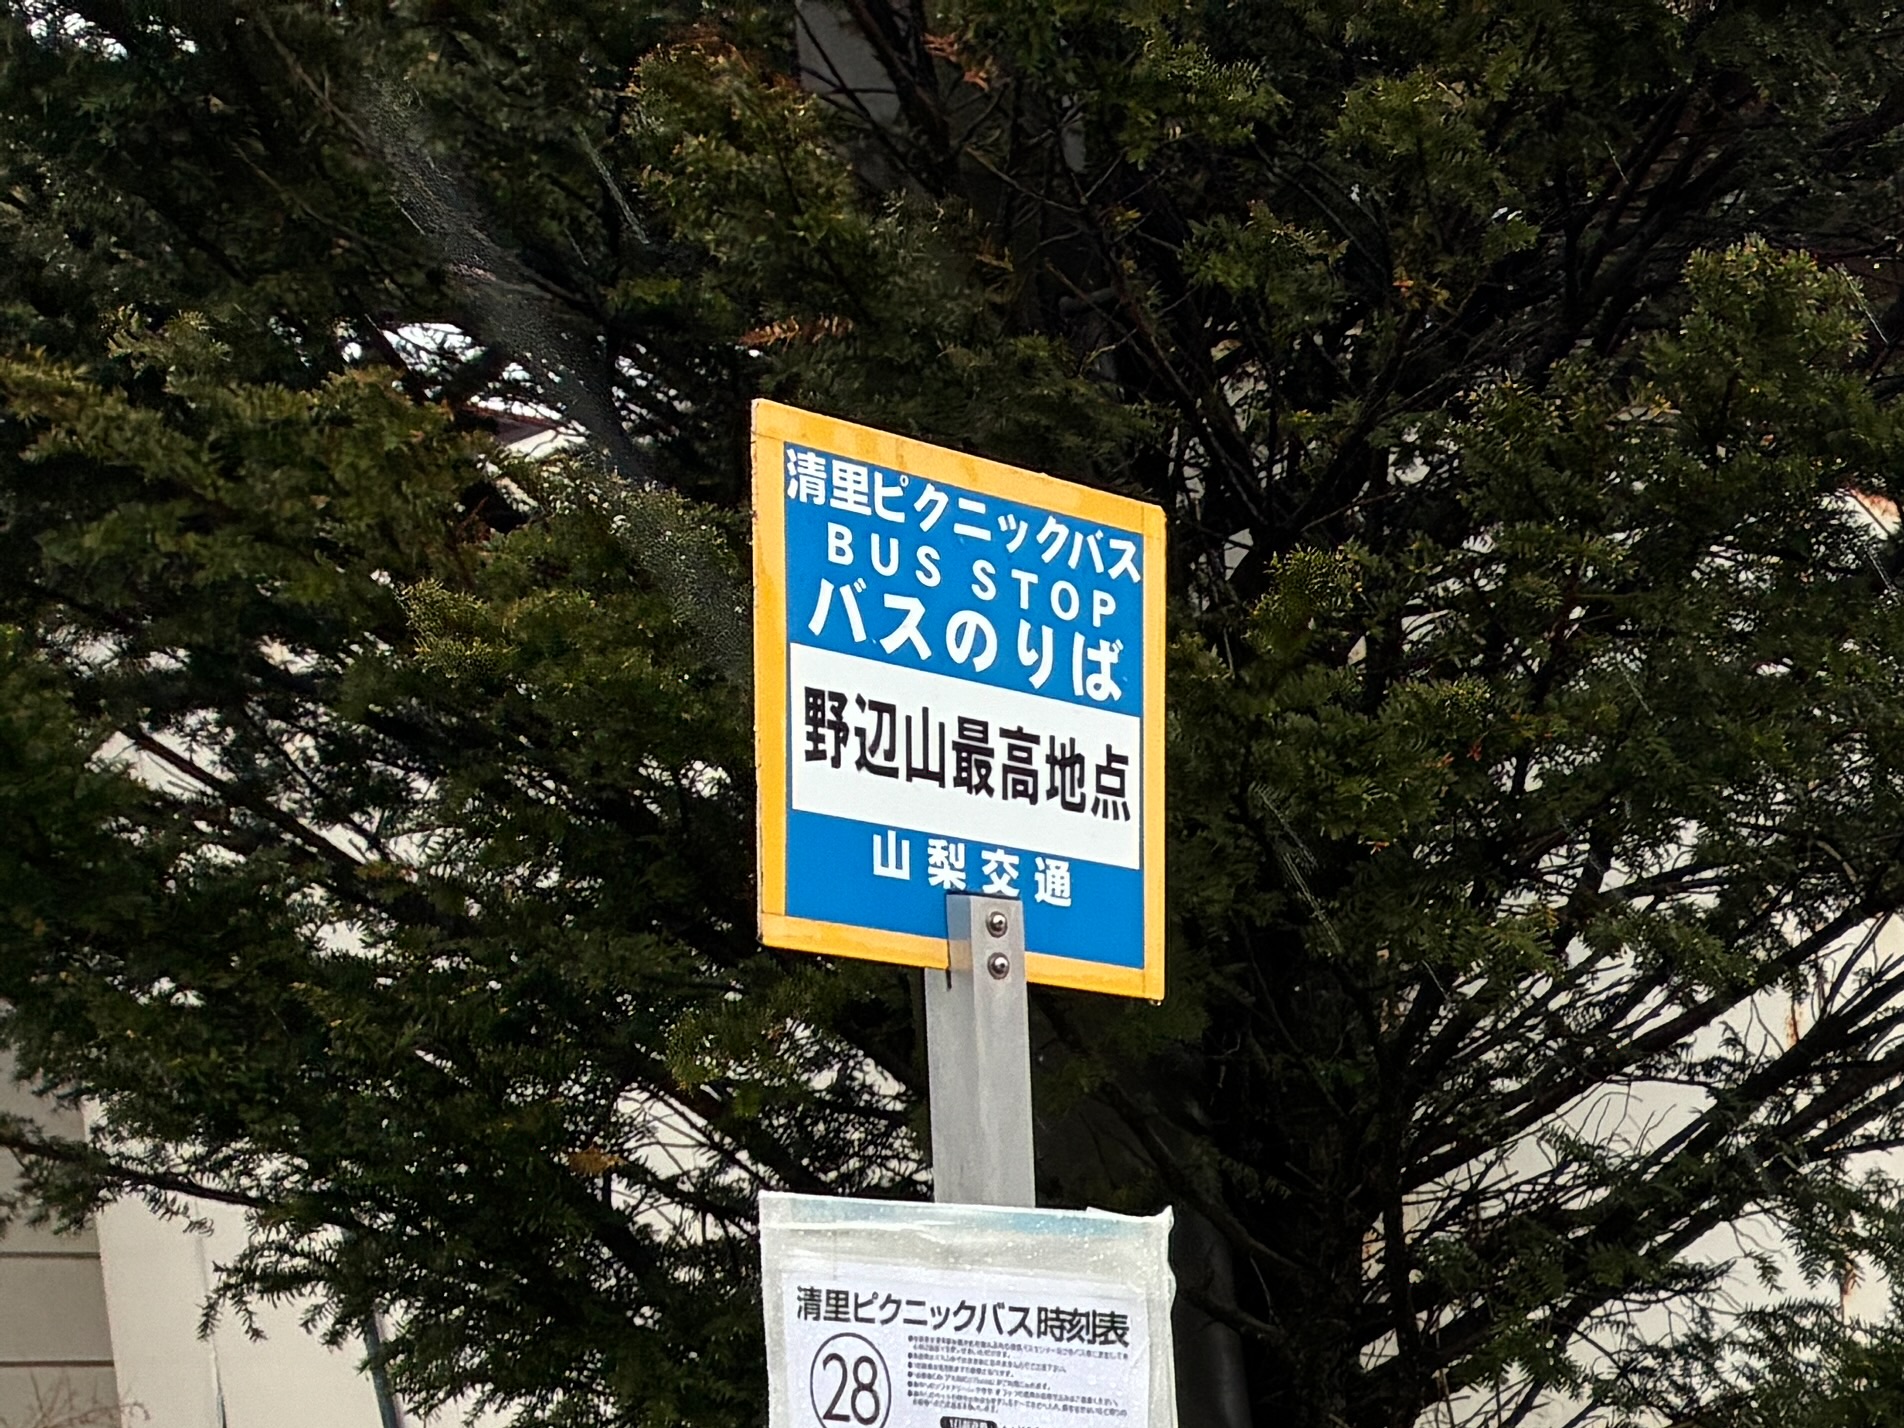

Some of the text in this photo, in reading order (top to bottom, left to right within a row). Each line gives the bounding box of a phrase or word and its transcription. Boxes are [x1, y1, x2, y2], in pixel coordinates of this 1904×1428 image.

[786, 448, 1143, 584] 清里ピクニックバス
[827, 521, 1118, 628] BUS STOP
[808, 577, 1125, 702] バスのりば
[804, 686, 1132, 822] 野辺山最高地点
[873, 829, 1073, 908] 山梨交通
[796, 1284, 1131, 1347] 清里ピクニックバス時刻表
[821, 1352, 881, 1426] 28
